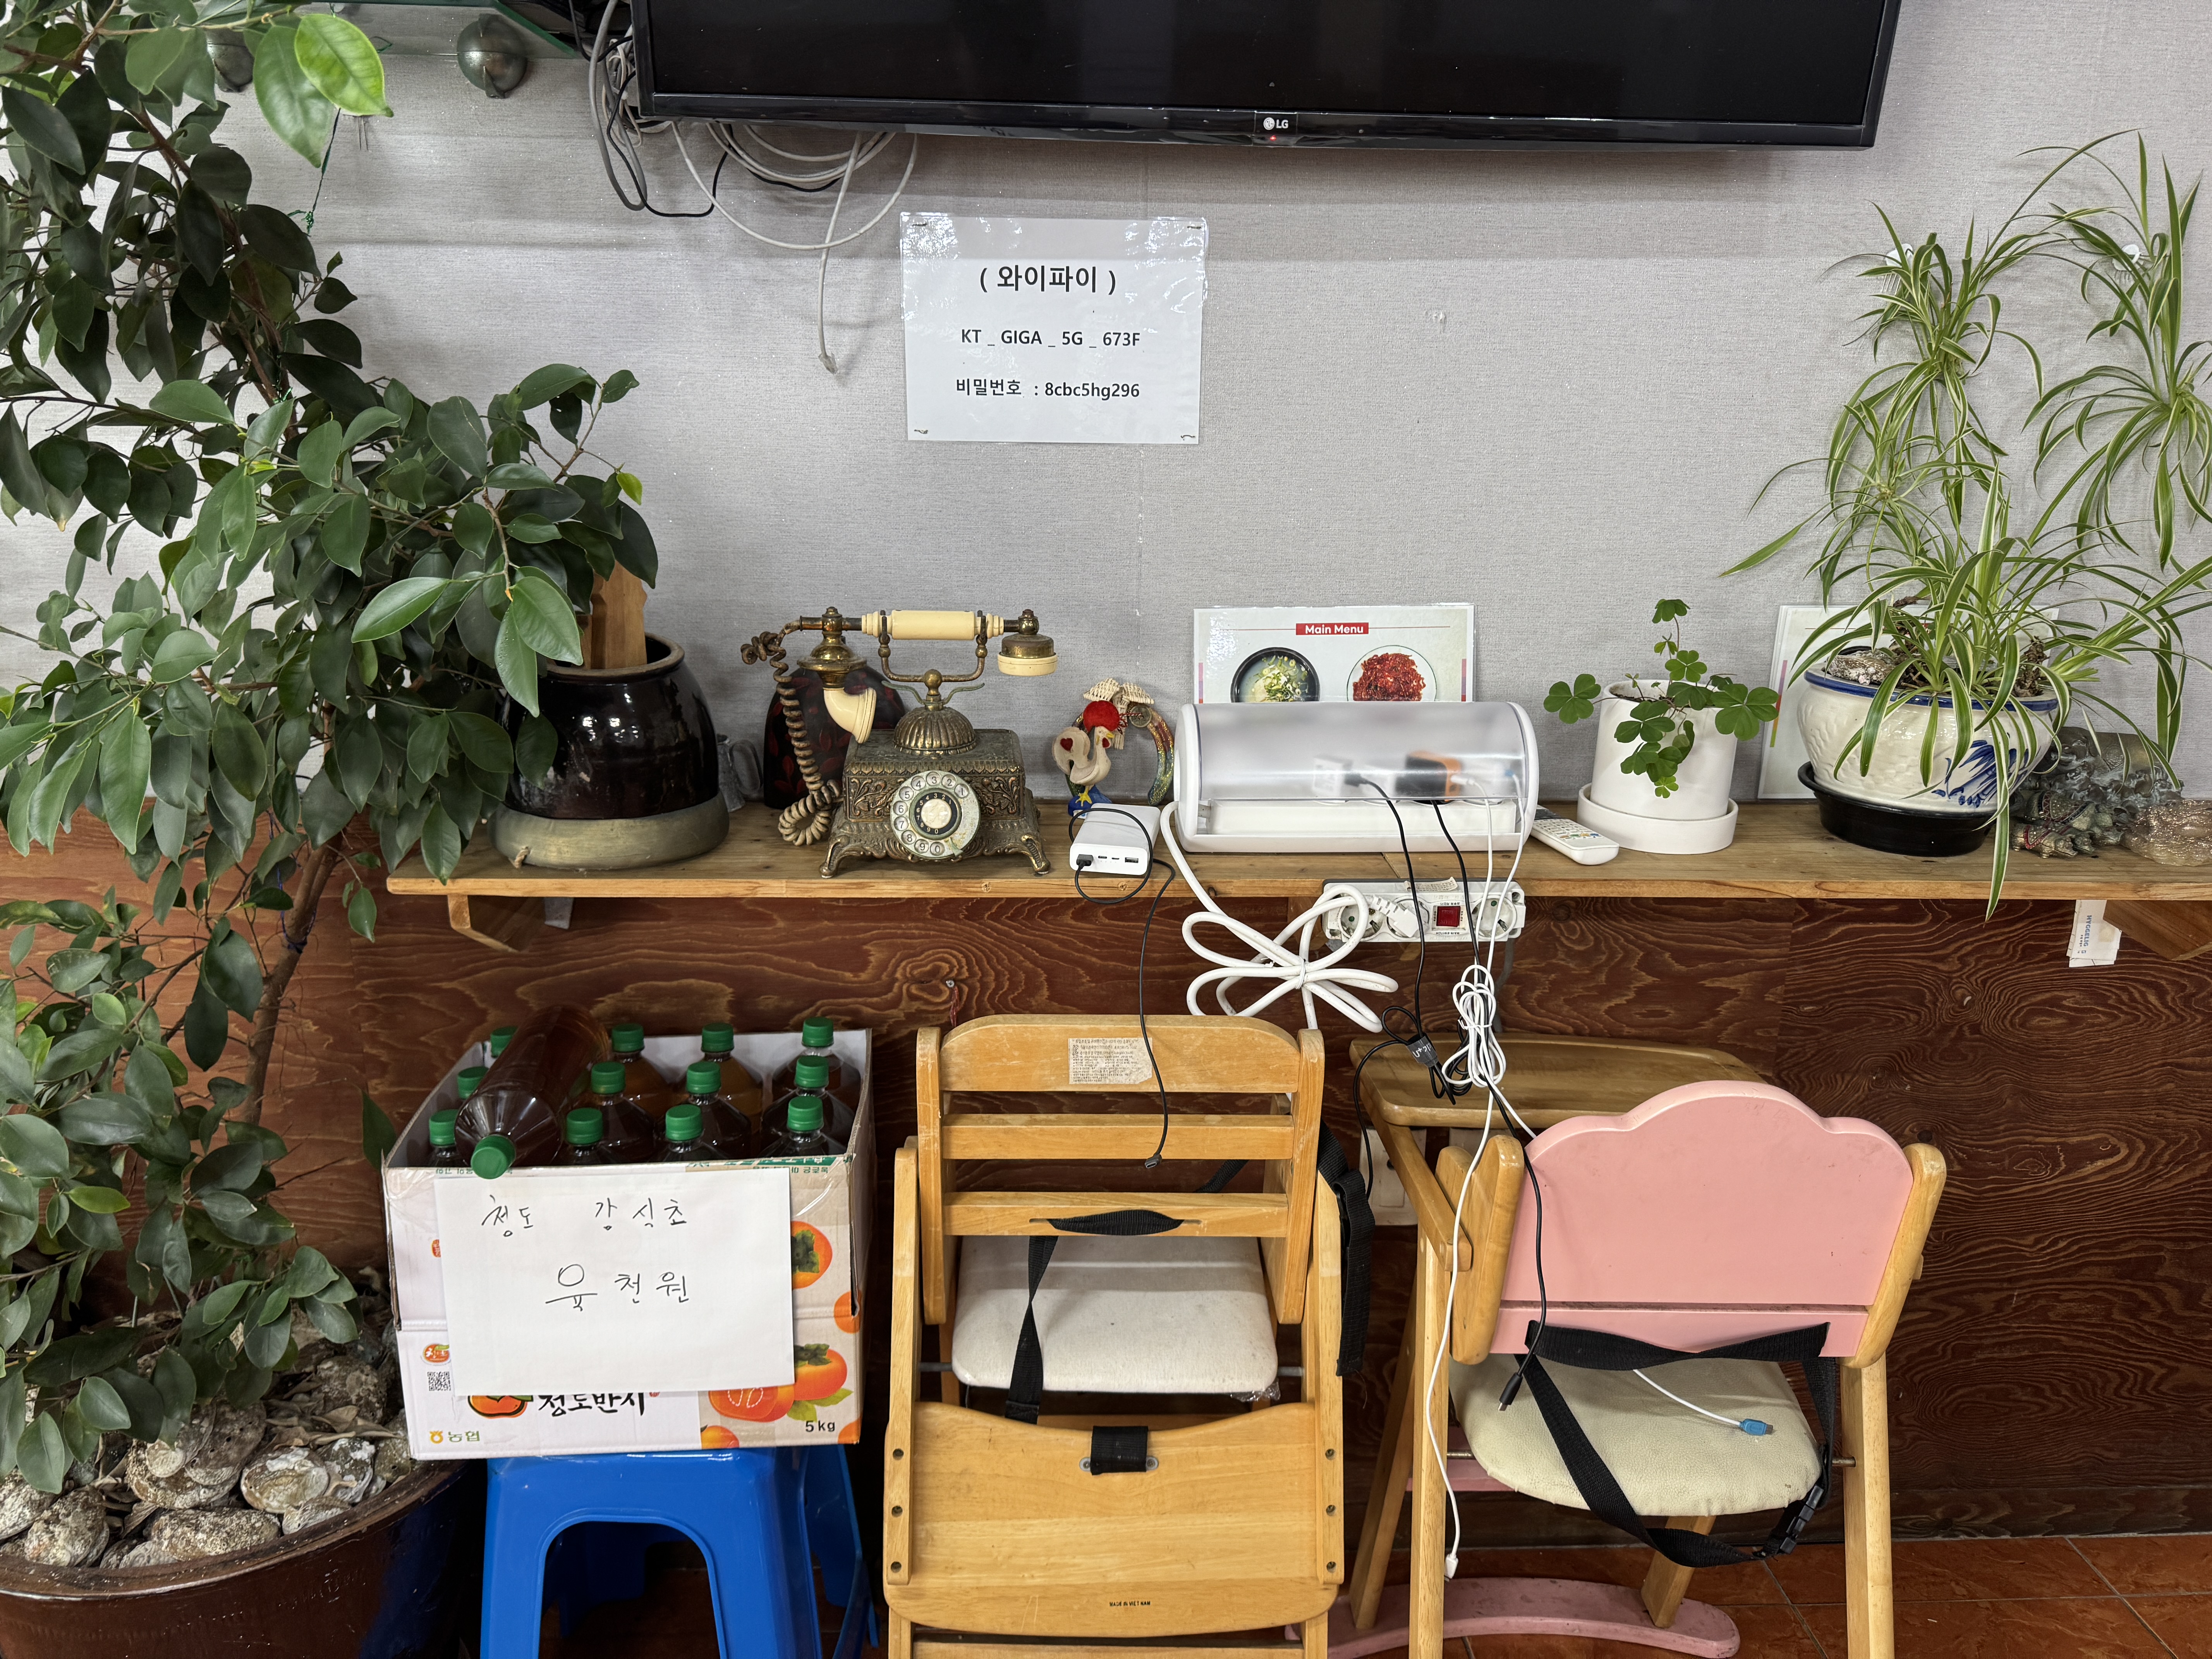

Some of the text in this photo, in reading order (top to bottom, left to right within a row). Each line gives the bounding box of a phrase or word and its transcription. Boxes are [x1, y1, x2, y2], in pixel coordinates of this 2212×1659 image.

[1276, 119, 1288, 129] LG
[997, 265, 1096, 293] 와이파이
[962, 329, 982, 343] KT
[1001, 330, 1042, 344] GIGA
[1062, 331, 1082, 345] 5G
[1103, 332, 1140, 346] 673F
[957, 378, 1021, 396] 비밀번호
[1045, 382, 1139, 401] 8cbc5hg296
[1305, 624, 1364, 634] Main Menu
[899, 821, 904, 829] 7
[907, 834, 912, 842] 8
[481, 1195, 533, 1237] 청도
[448, 1431, 480, 1443] 농협
